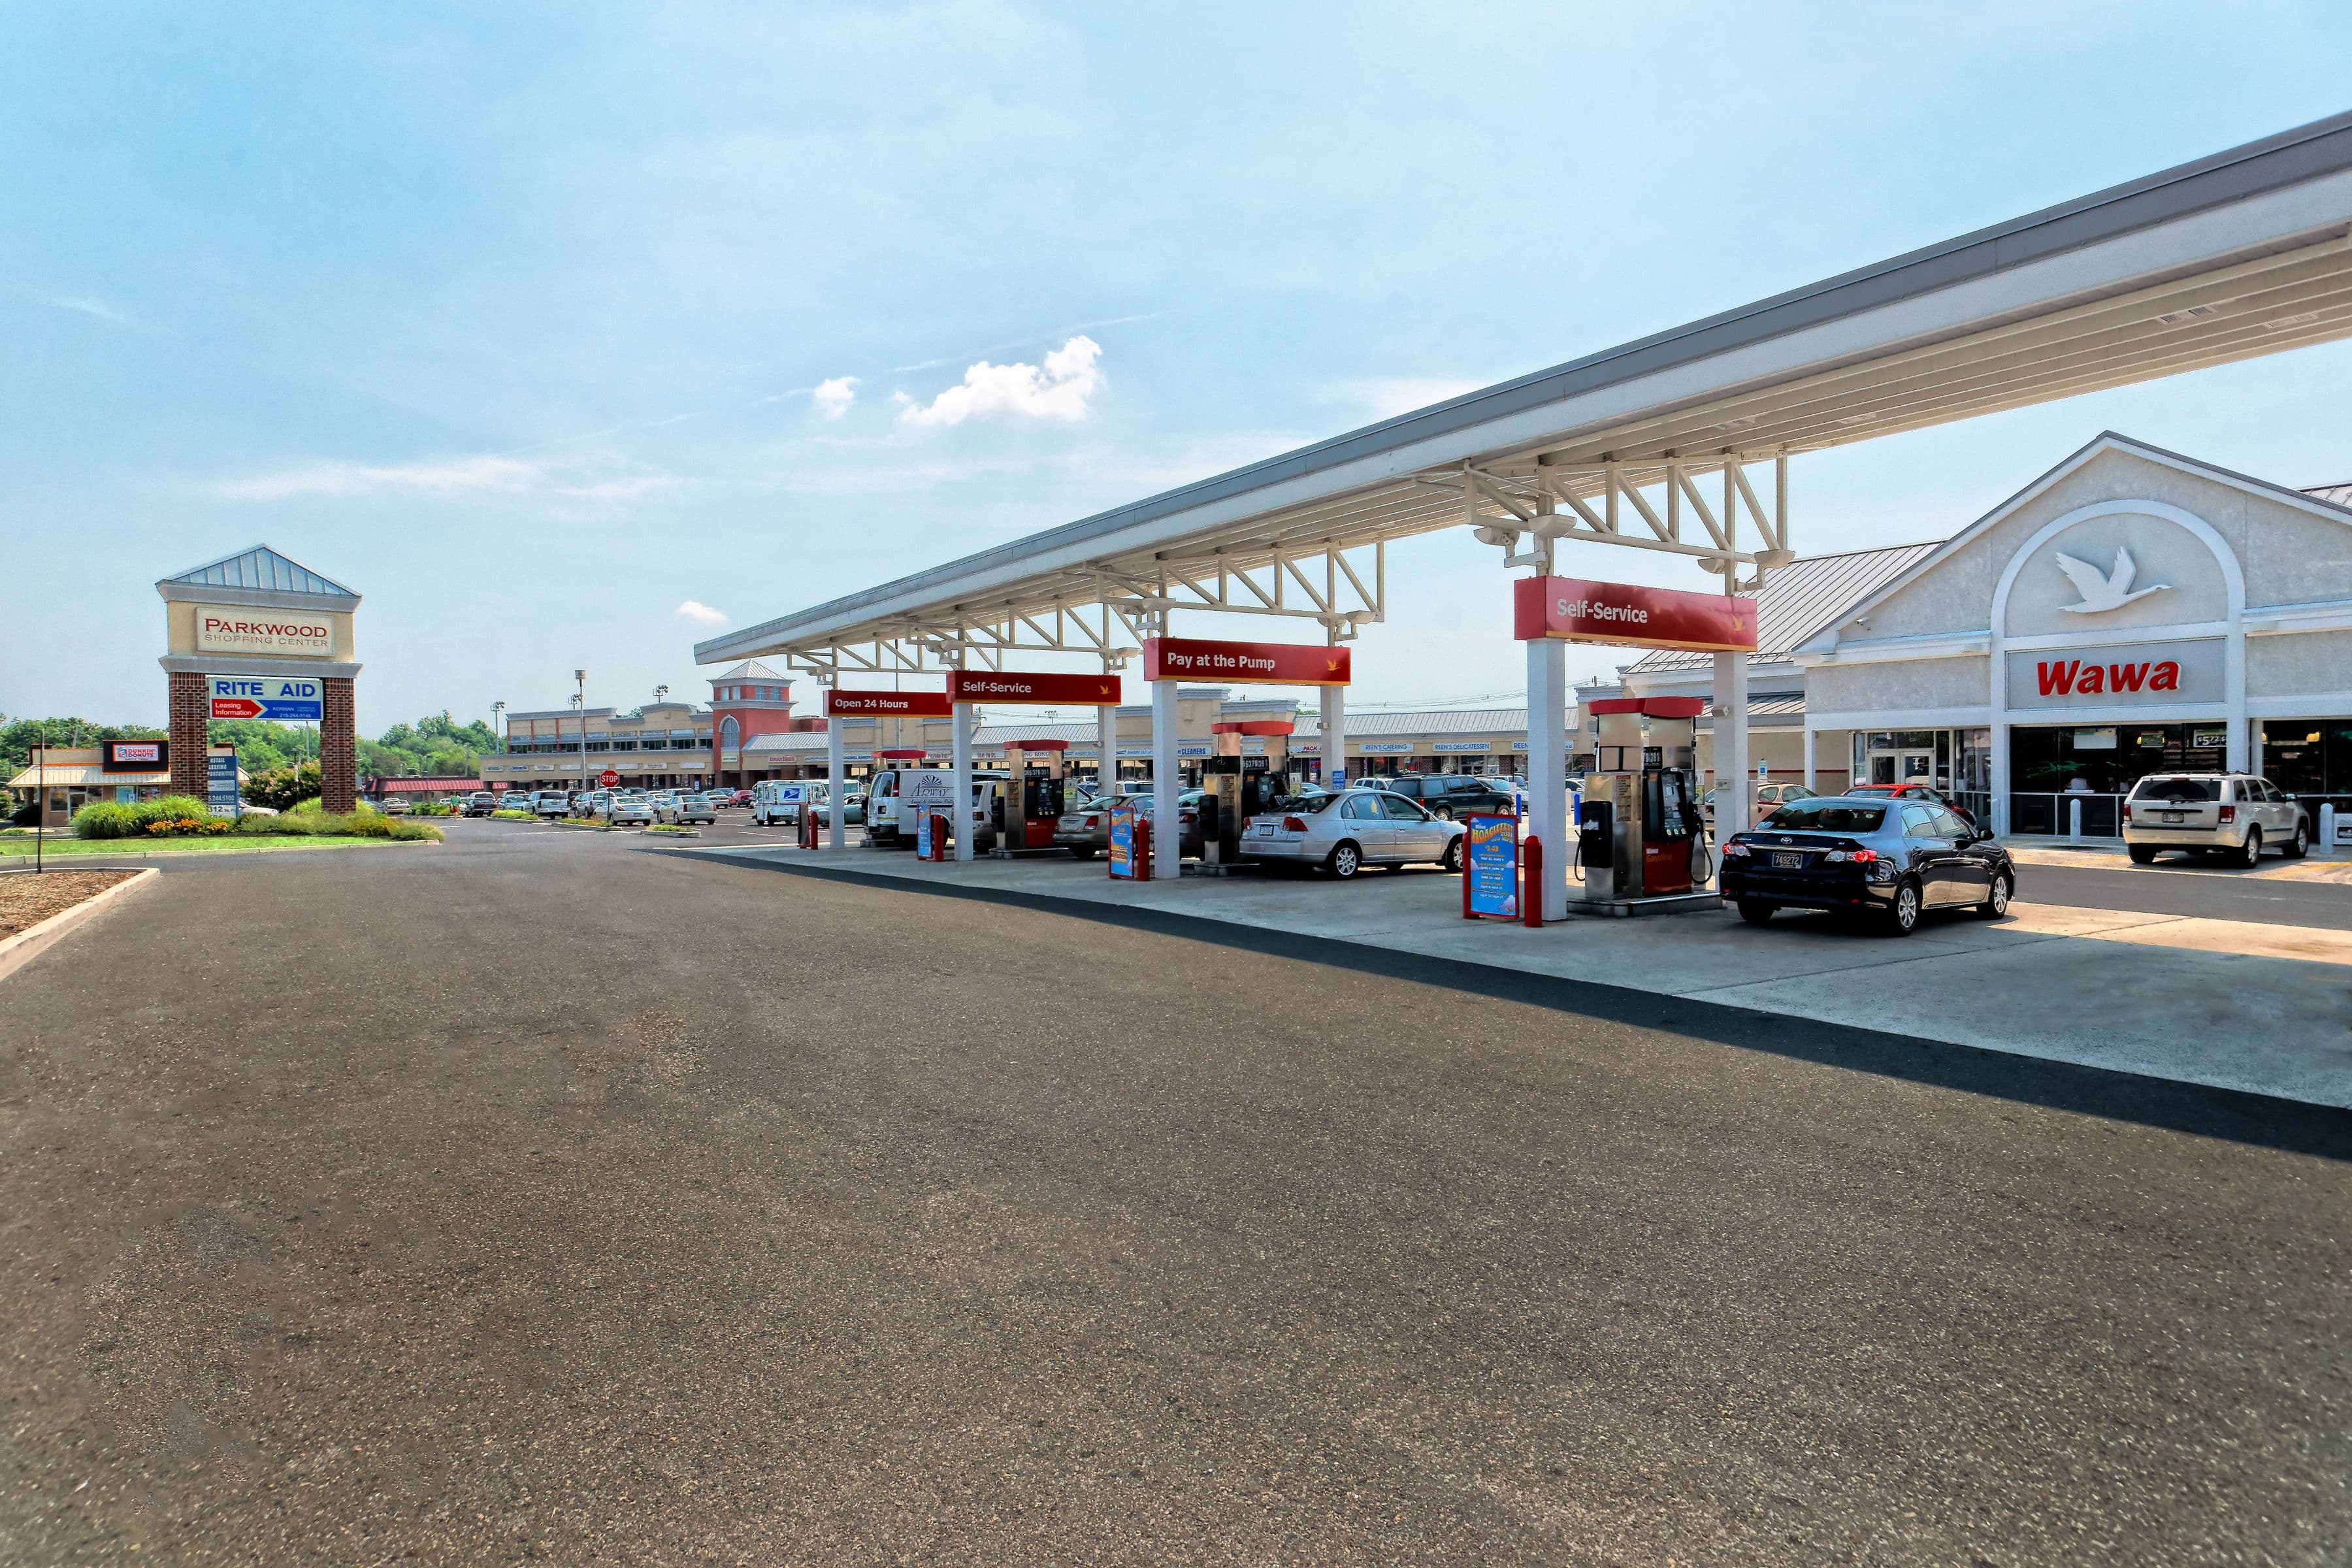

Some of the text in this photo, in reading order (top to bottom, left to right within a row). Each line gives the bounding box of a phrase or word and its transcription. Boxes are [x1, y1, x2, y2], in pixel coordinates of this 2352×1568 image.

[1557, 598, 1648, 623] Self-Service
[204, 618, 327, 638] PARKWOOD
[204, 634, 328, 646] SHOPPING CENTER
[1168, 652, 1275, 671] Pay at the Pump
[2037, 660, 2181, 696] Wawa
[216, 681, 316, 697] RITE AID
[962, 681, 1032, 693] Self-Service
[835, 699, 909, 709] Open 24 Hours
[1775, 855, 1799, 864] 749272
